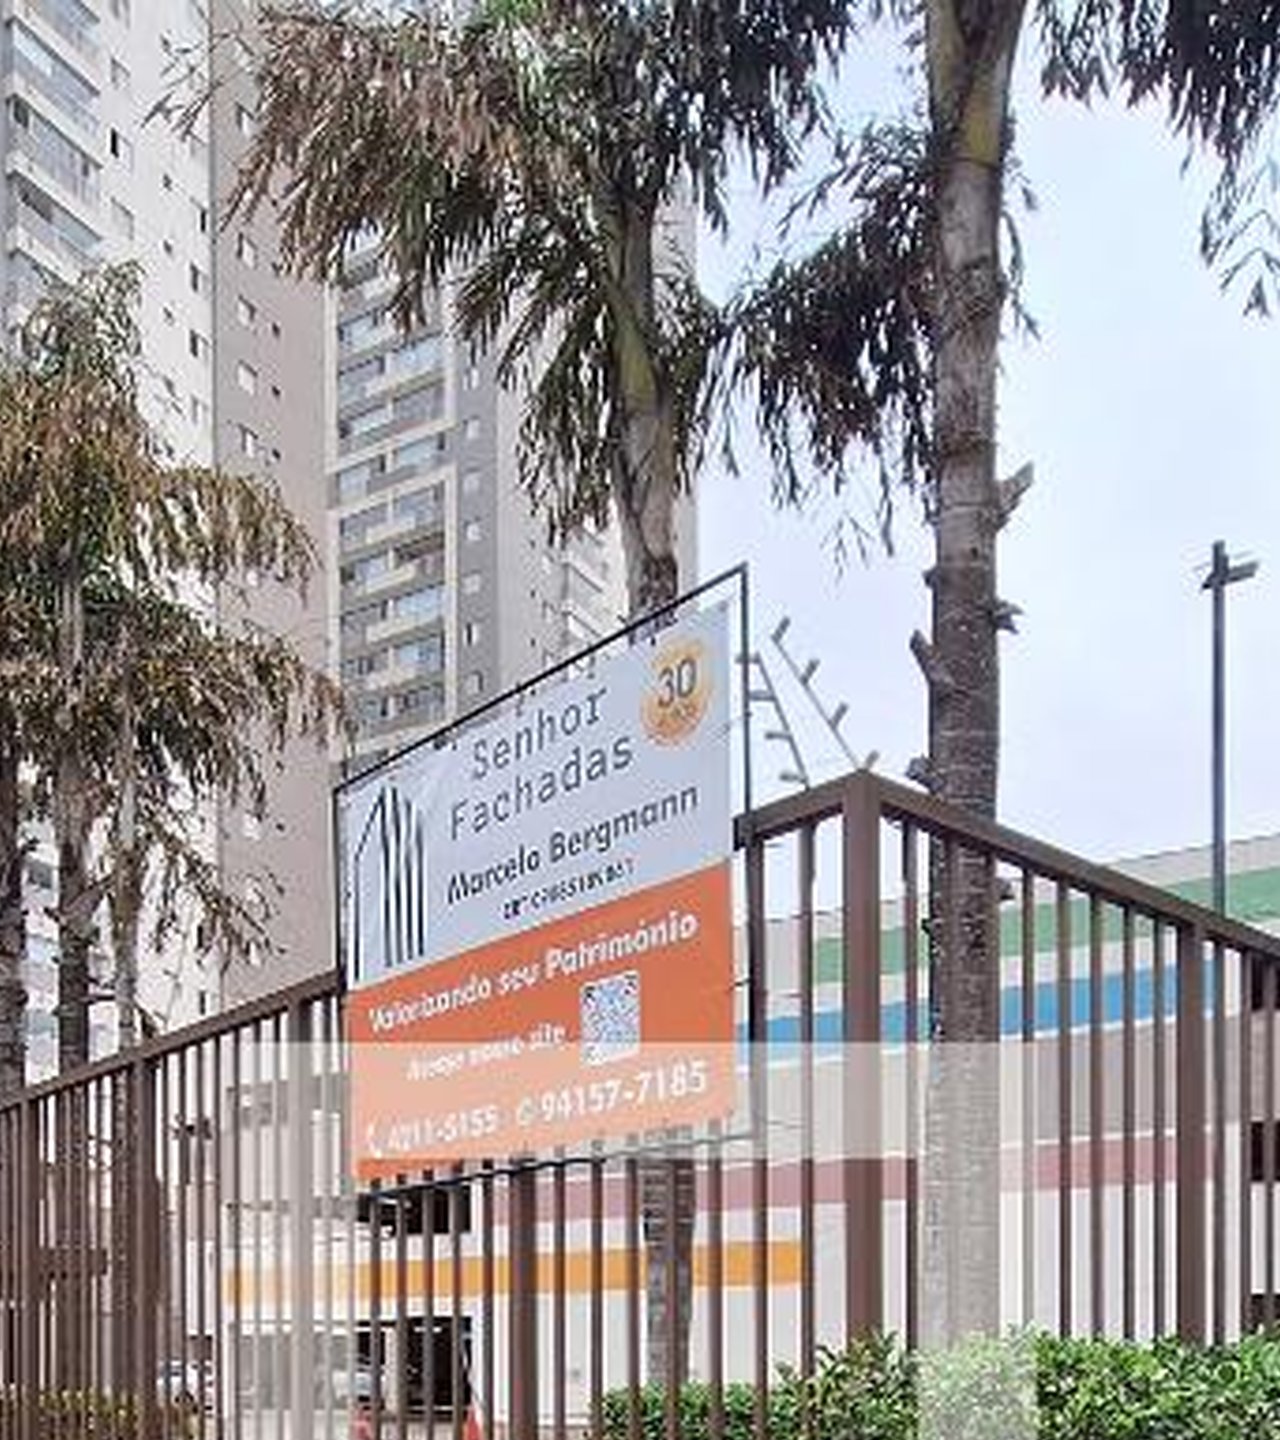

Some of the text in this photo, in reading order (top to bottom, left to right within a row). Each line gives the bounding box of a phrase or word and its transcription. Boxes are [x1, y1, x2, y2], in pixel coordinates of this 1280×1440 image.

[658, 657, 697, 708] 30
[472, 686, 607, 780] Senhor
[450, 736, 633, 841] Fachadas
[447, 844, 540, 905] Marcelo
[549, 785, 698, 863] Bergmann
[498, 961, 540, 997] seu
[540, 1060, 708, 1122] 94157-7185
